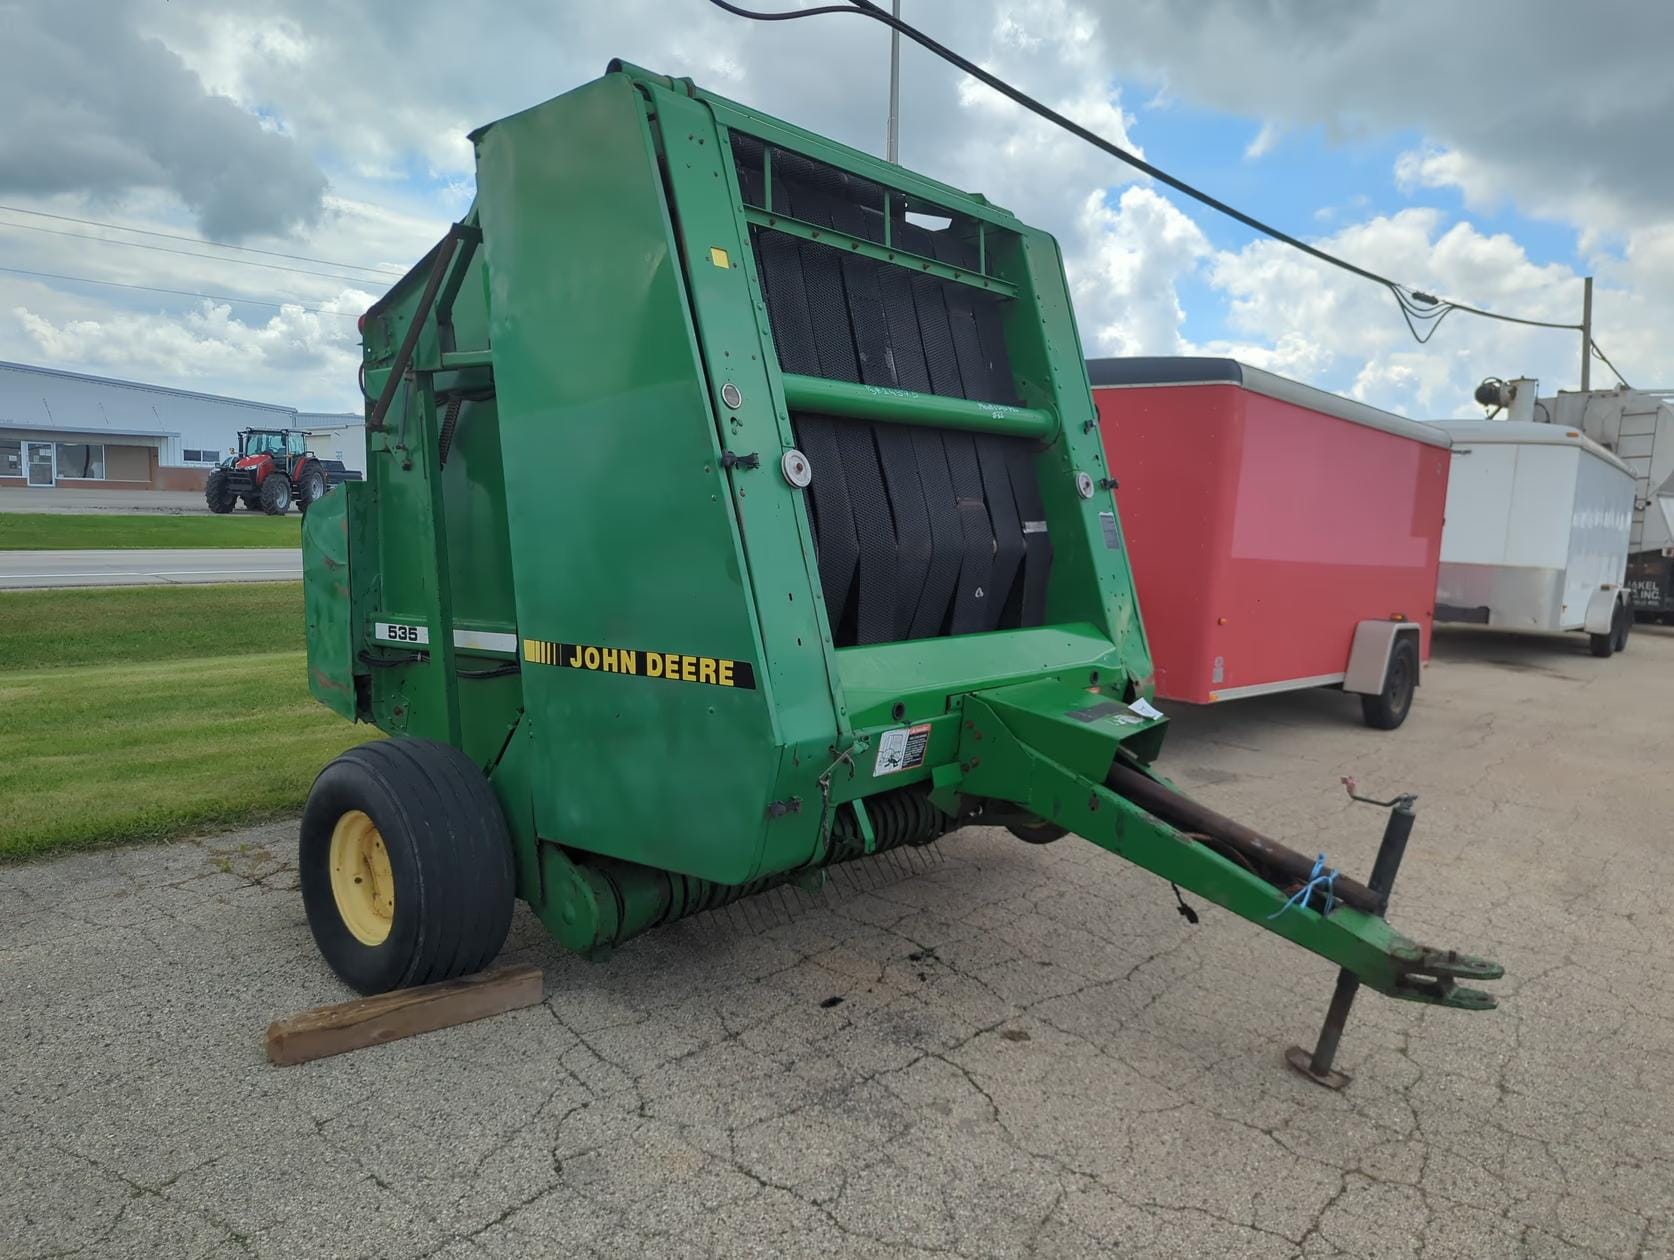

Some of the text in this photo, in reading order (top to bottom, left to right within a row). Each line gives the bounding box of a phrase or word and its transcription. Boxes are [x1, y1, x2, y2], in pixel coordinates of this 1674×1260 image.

[388, 625, 418, 641] 535
[570, 645, 734, 686] JOHN DEERE
